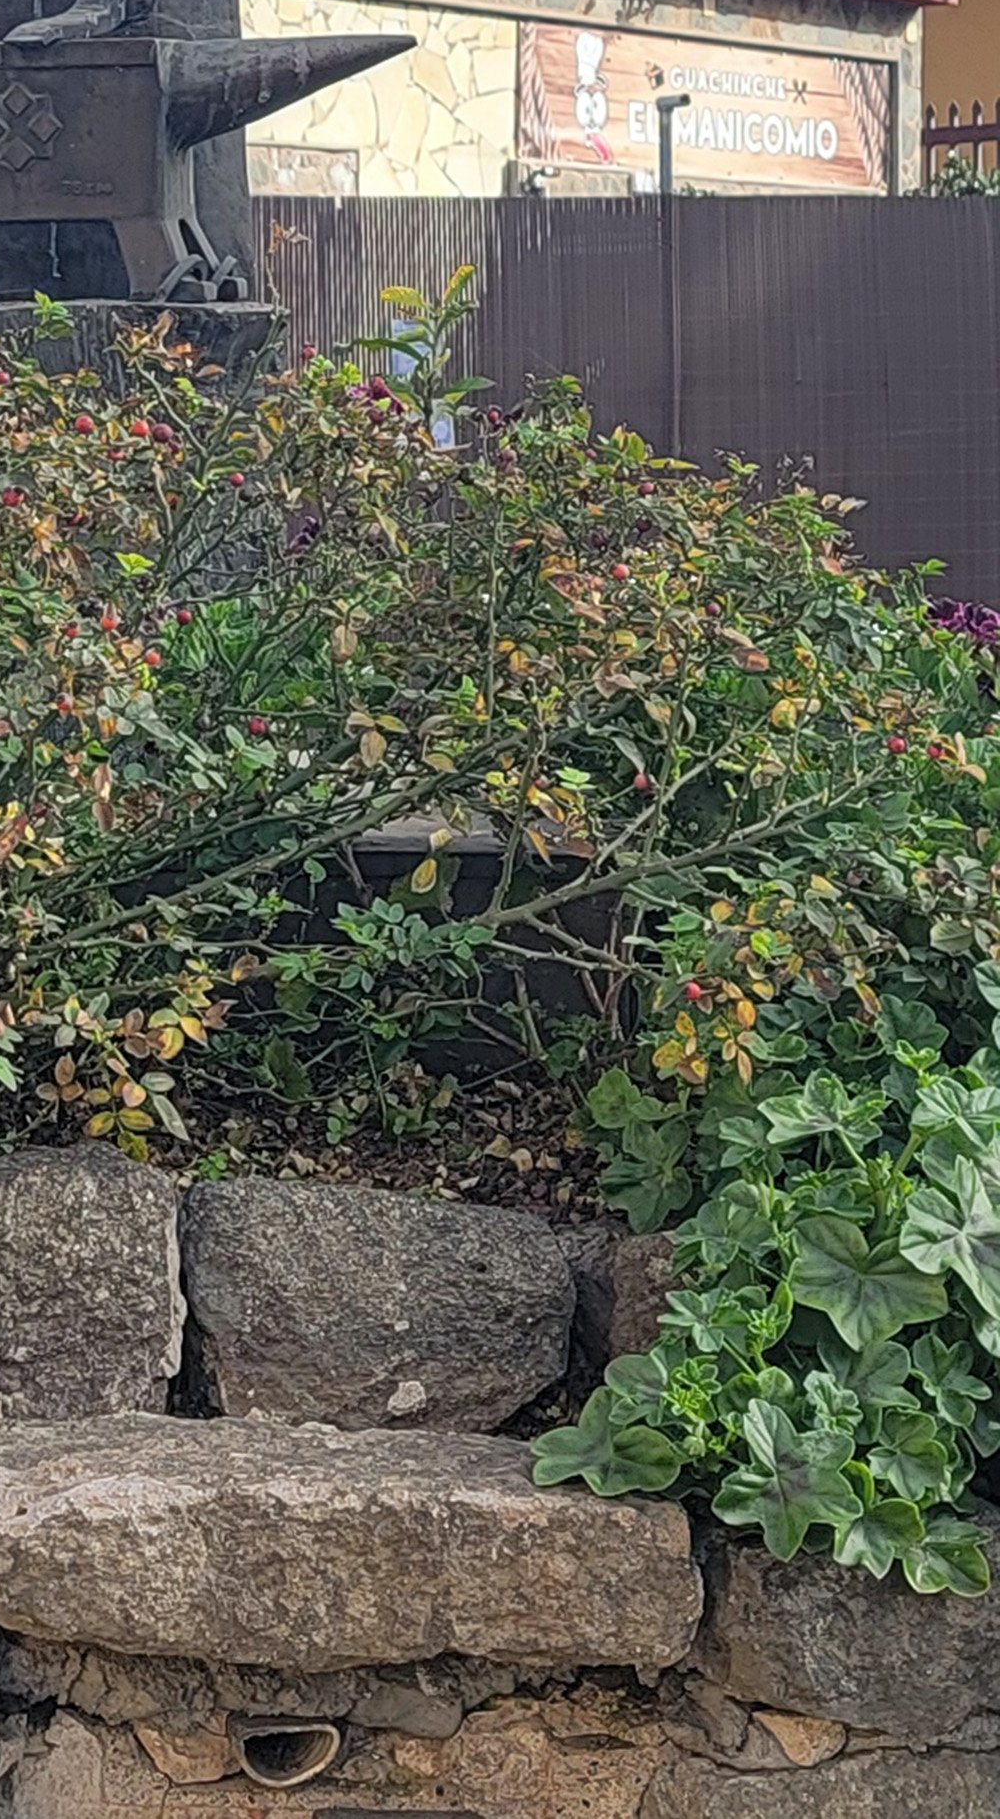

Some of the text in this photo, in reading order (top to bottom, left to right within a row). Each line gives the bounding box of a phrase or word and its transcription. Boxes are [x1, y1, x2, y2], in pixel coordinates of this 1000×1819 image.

[669, 65, 787, 100] GUACHINCHE
[628, 99, 838, 160] EL MANICOMIO
